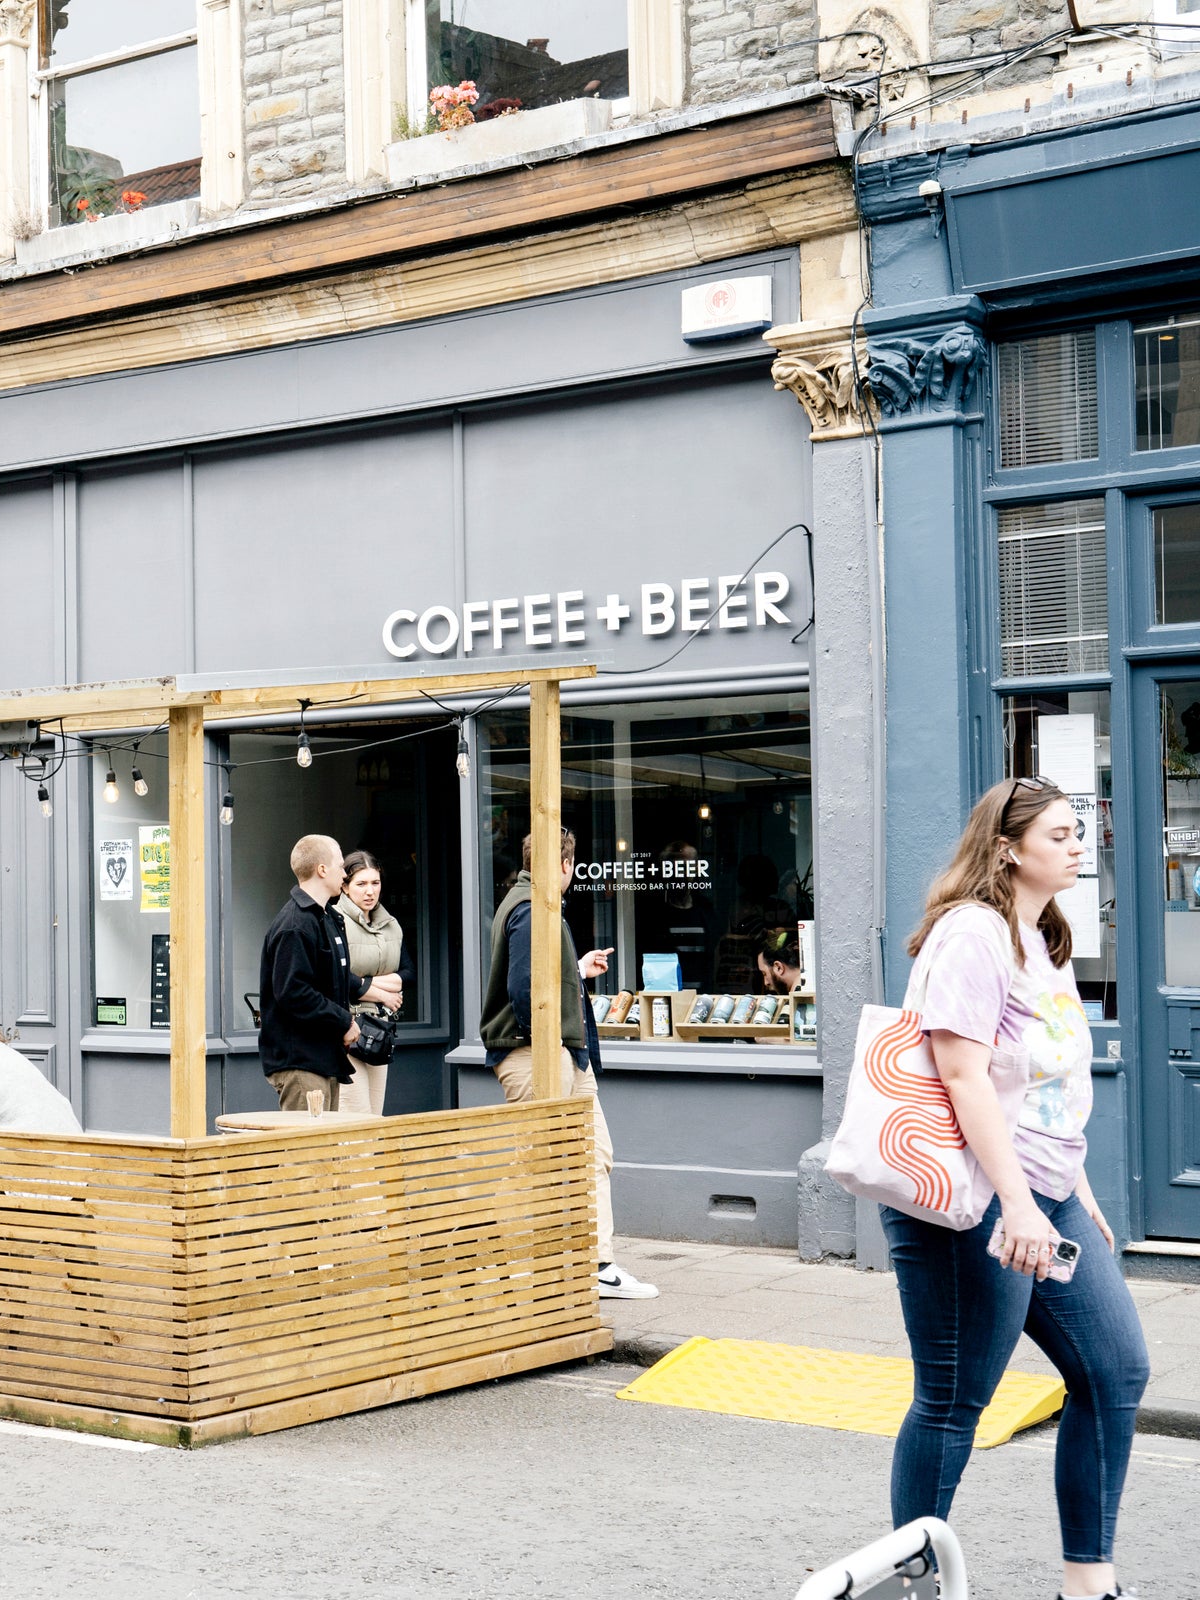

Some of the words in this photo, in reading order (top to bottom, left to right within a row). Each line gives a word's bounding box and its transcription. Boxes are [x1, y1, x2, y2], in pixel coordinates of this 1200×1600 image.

[382, 590, 586, 658] COFFEE
[597, 594, 631, 631] +
[641, 571, 792, 636] BEER
[1170, 832, 1197, 841] NHBF
[574, 861, 645, 880] COFFEE
[647, 863, 659, 876] +
[662, 860, 710, 878] BEER
[613, 882, 647, 891] ESPRESSO
[688, 882, 712, 890] ROOM
